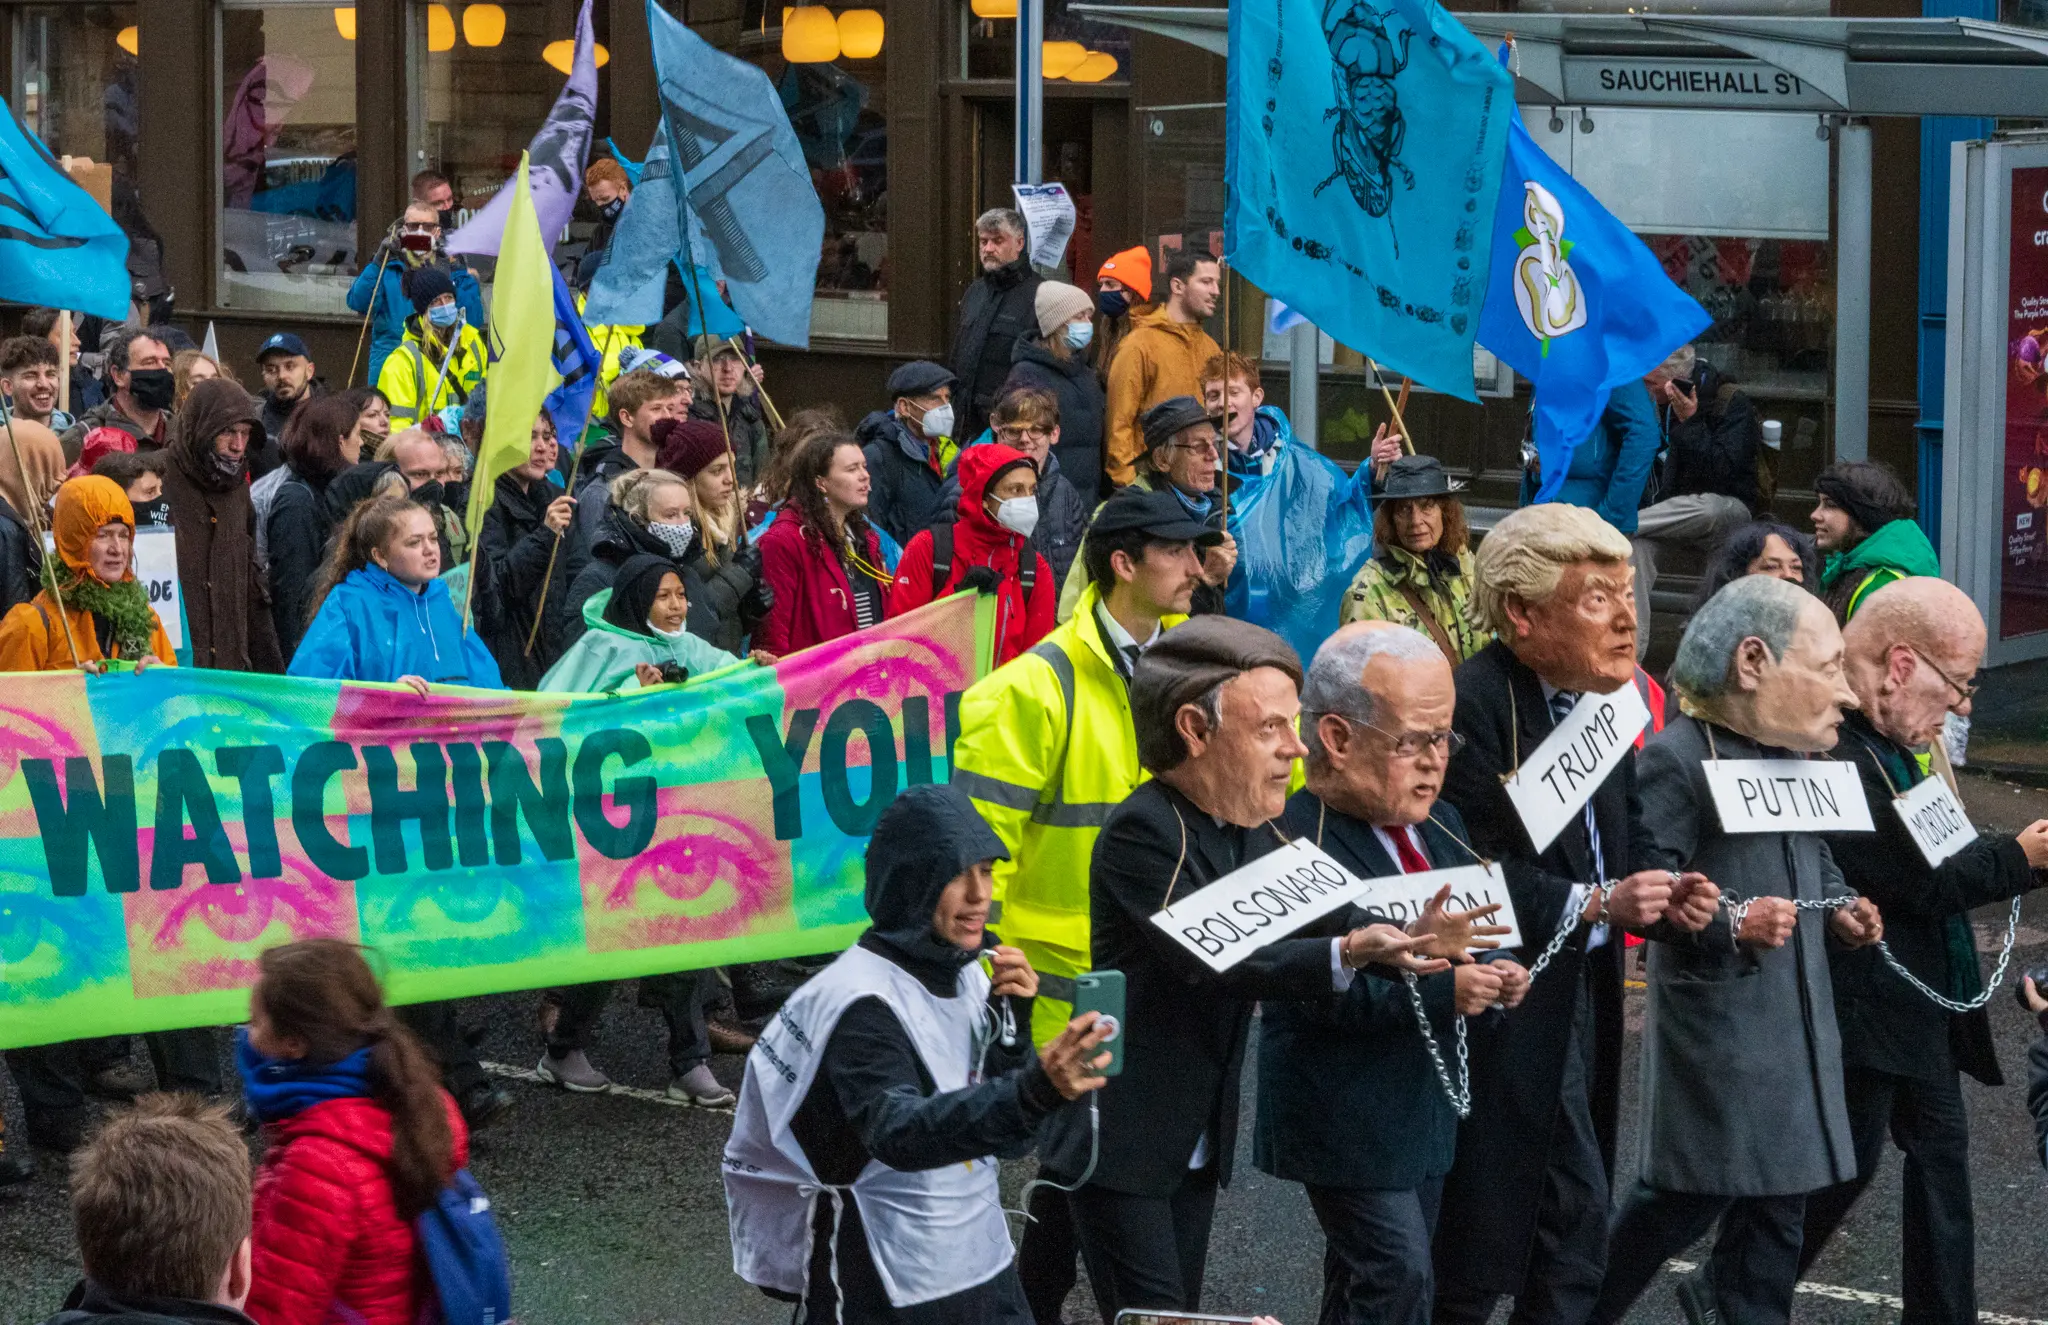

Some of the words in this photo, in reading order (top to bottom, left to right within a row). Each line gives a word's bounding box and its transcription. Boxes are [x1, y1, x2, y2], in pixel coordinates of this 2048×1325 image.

[1600, 68, 1768, 94] SAUCHIEHALL
[1774, 73, 1801, 95] ST
[145, 579, 173, 602] DE
[1540, 703, 1618, 804] TRUMP
[20, 728, 658, 897] WATCHING
[1738, 777, 1842, 817] PUTIN
[1910, 792, 1967, 851] MURDOCH
[1182, 860, 1347, 957] BOLSONARO
